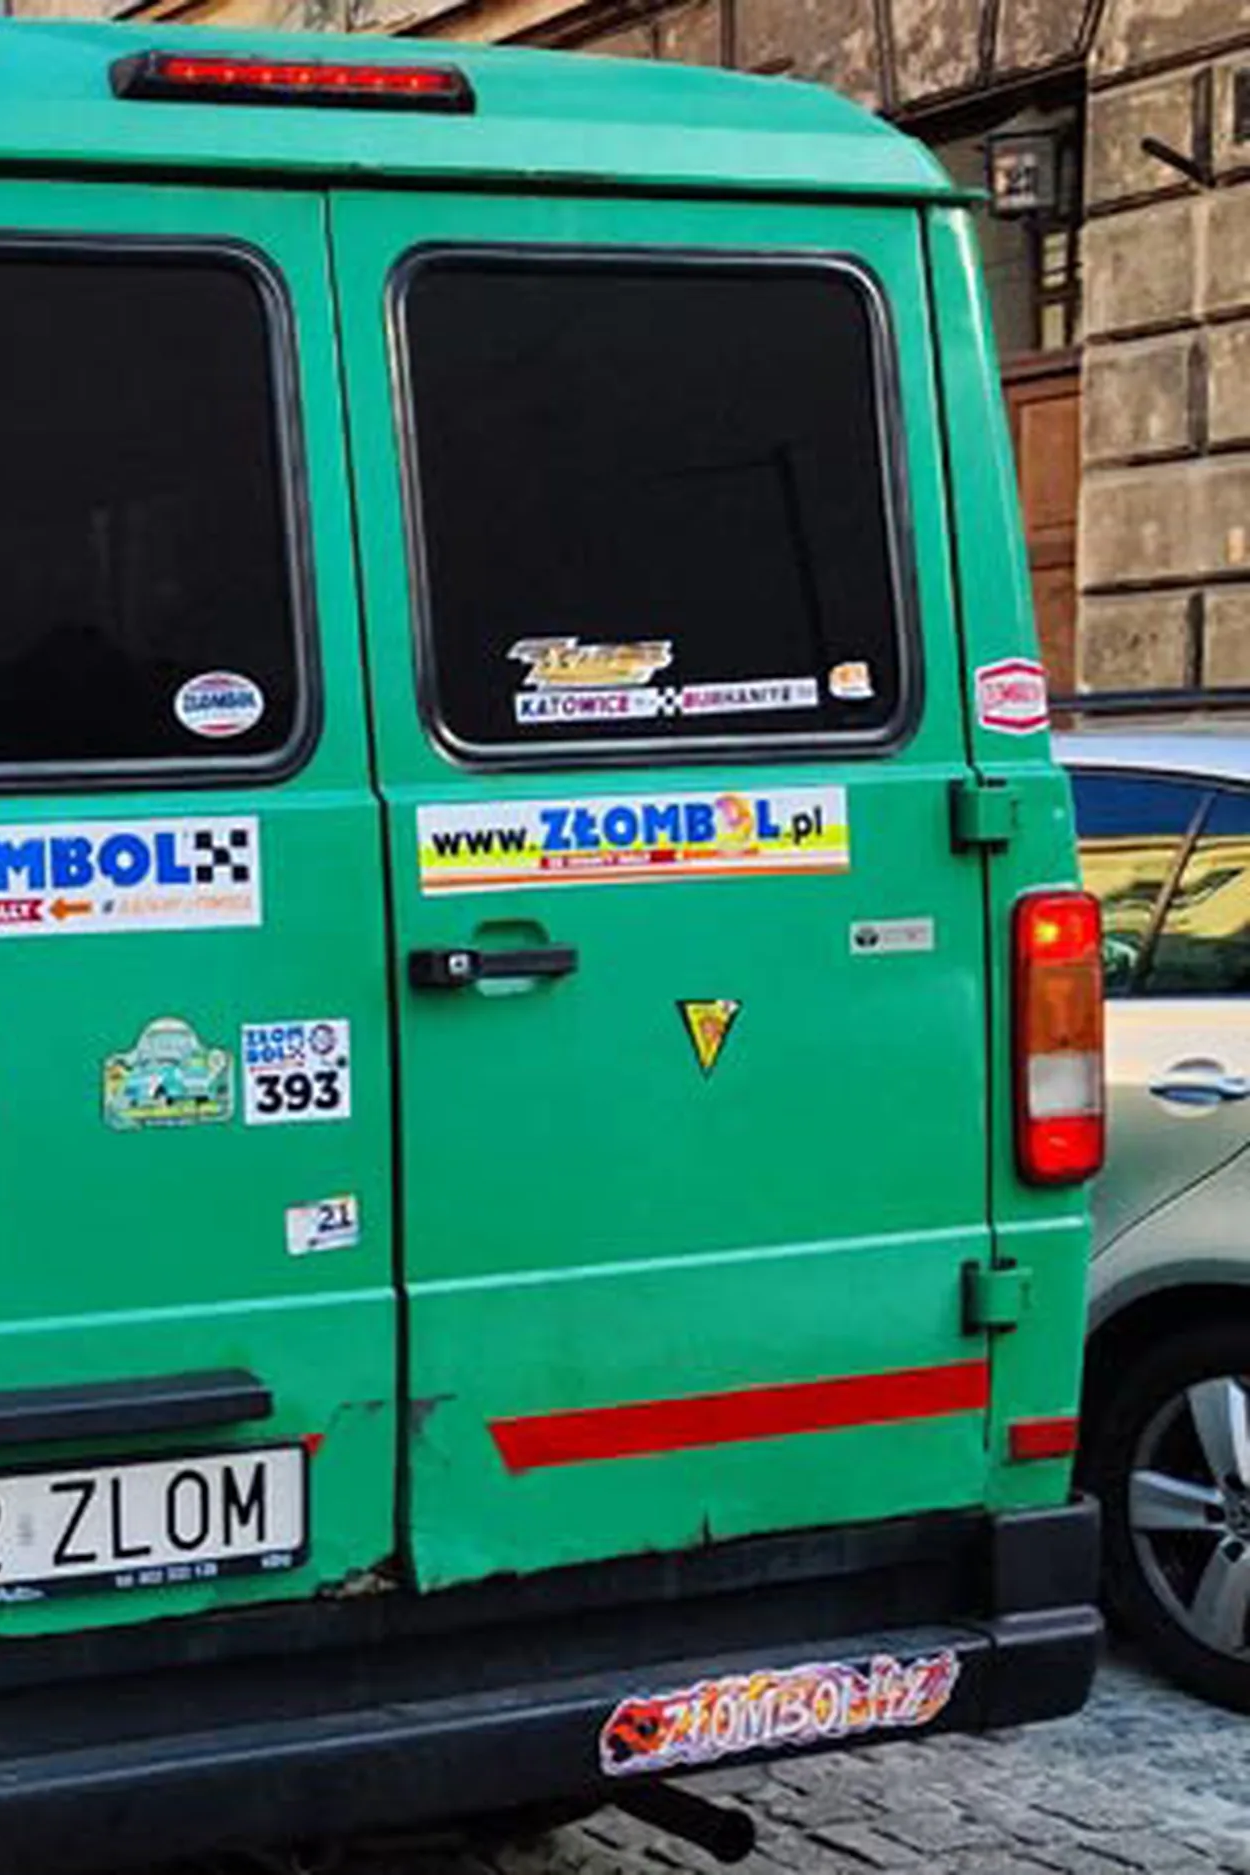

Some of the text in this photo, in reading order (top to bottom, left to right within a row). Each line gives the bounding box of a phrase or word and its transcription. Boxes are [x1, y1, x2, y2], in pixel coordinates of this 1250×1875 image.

[521, 694, 630, 717] KATOWICE
[256, 1070, 340, 1113] 393
[318, 1204, 352, 1233] 21
[49, 1462, 266, 1567] ZLOM
